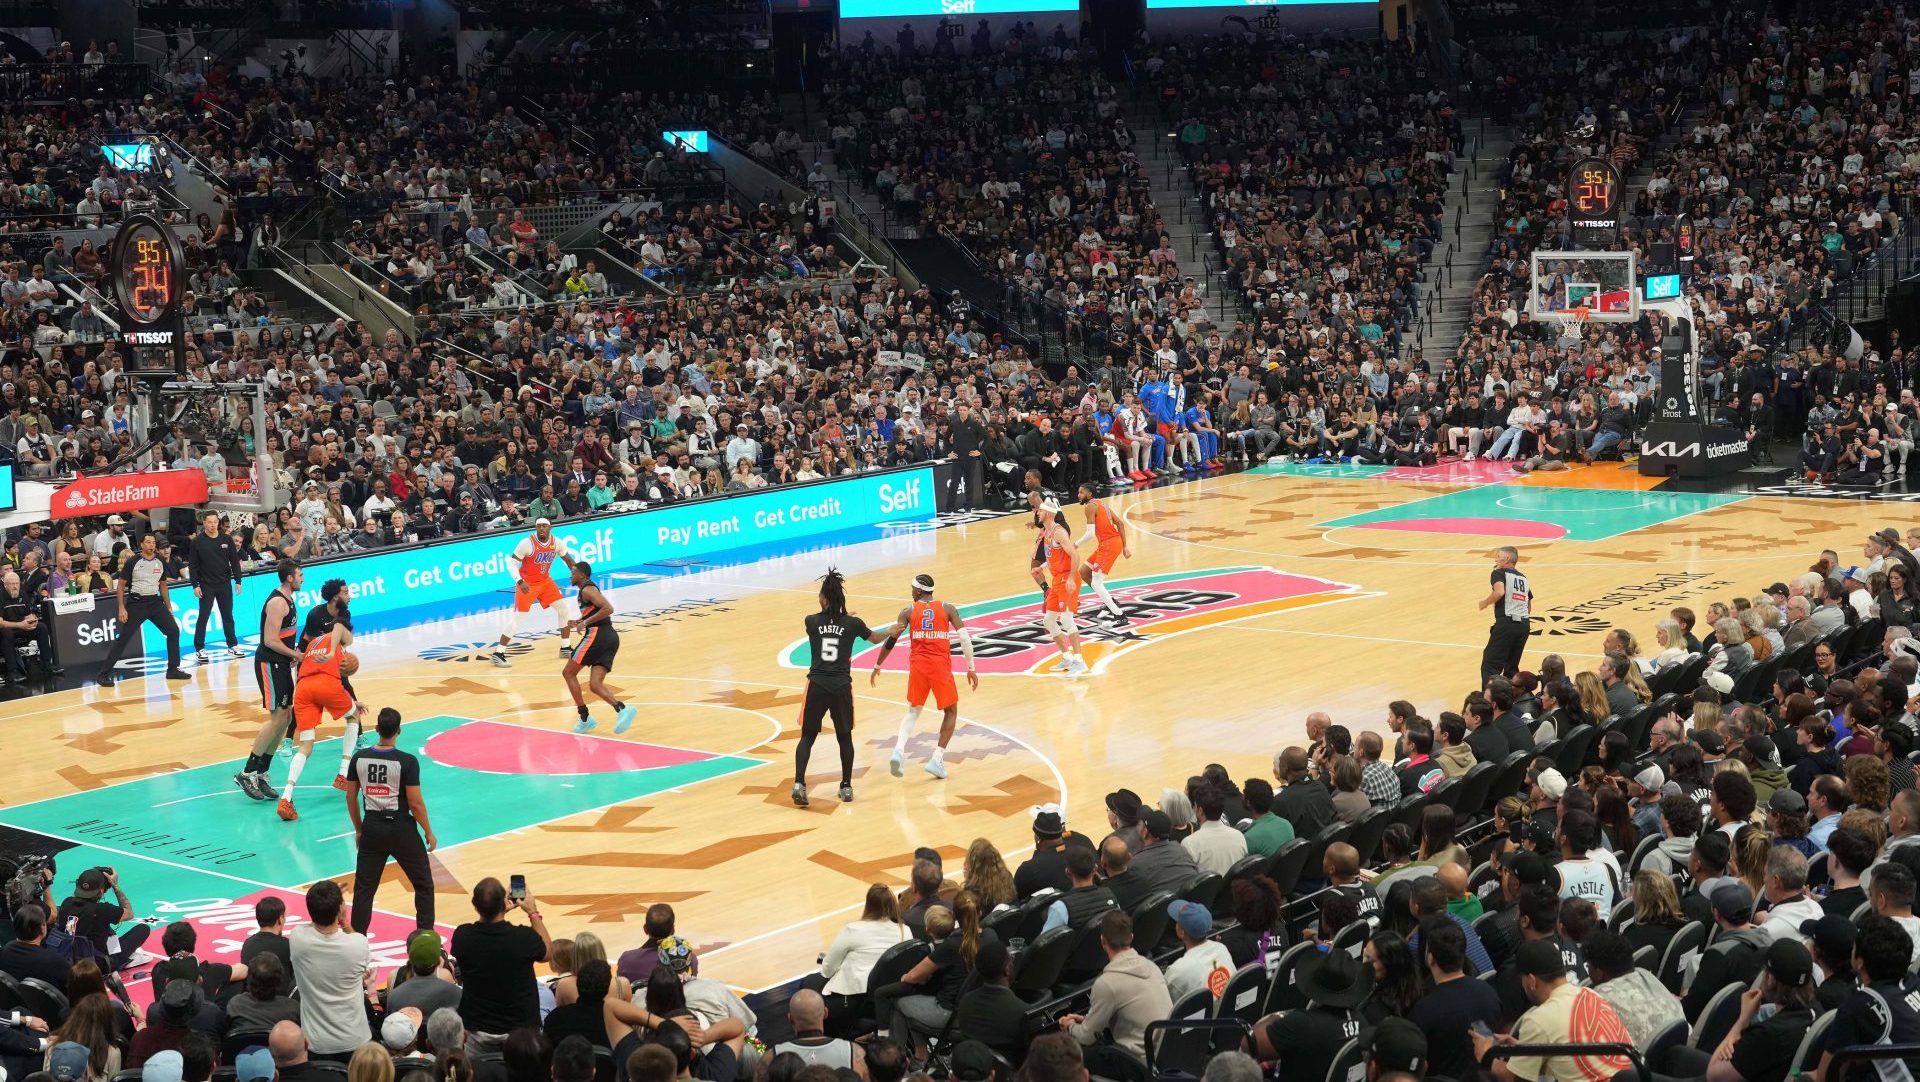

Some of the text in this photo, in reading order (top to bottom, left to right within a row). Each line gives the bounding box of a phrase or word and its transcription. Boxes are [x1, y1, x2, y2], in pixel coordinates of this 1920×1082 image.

[1584, 171, 1610, 184] 9:51
[1579, 185, 1608, 209] 24
[133, 266, 168, 309] 24
[1654, 279, 1672, 297] Self
[137, 332, 173, 344] TISSOT
[1662, 409, 1682, 418] Frost
[1706, 440, 1748, 459] ticketmaster
[88, 485, 160, 506] StateFarm
[879, 478, 921, 514] Self
[657, 500, 842, 545] Pay Rent Get Credit
[565, 528, 614, 565] Self
[403, 562, 442, 589] Get
[448, 552, 511, 580] Credit
[1514, 578, 1525, 592] 48
[61, 597, 87, 607] GATORADE
[1632, 580, 1737, 612] CENTER
[921, 609, 934, 630] 2
[818, 624, 845, 636] CASTLE
[821, 637, 839, 662] 5
[367, 764, 388, 784] 82
[367, 787, 389, 795] Emirates
[1570, 882, 1605, 897] CASTLE
[1342, 1020, 1360, 1037] FOX
